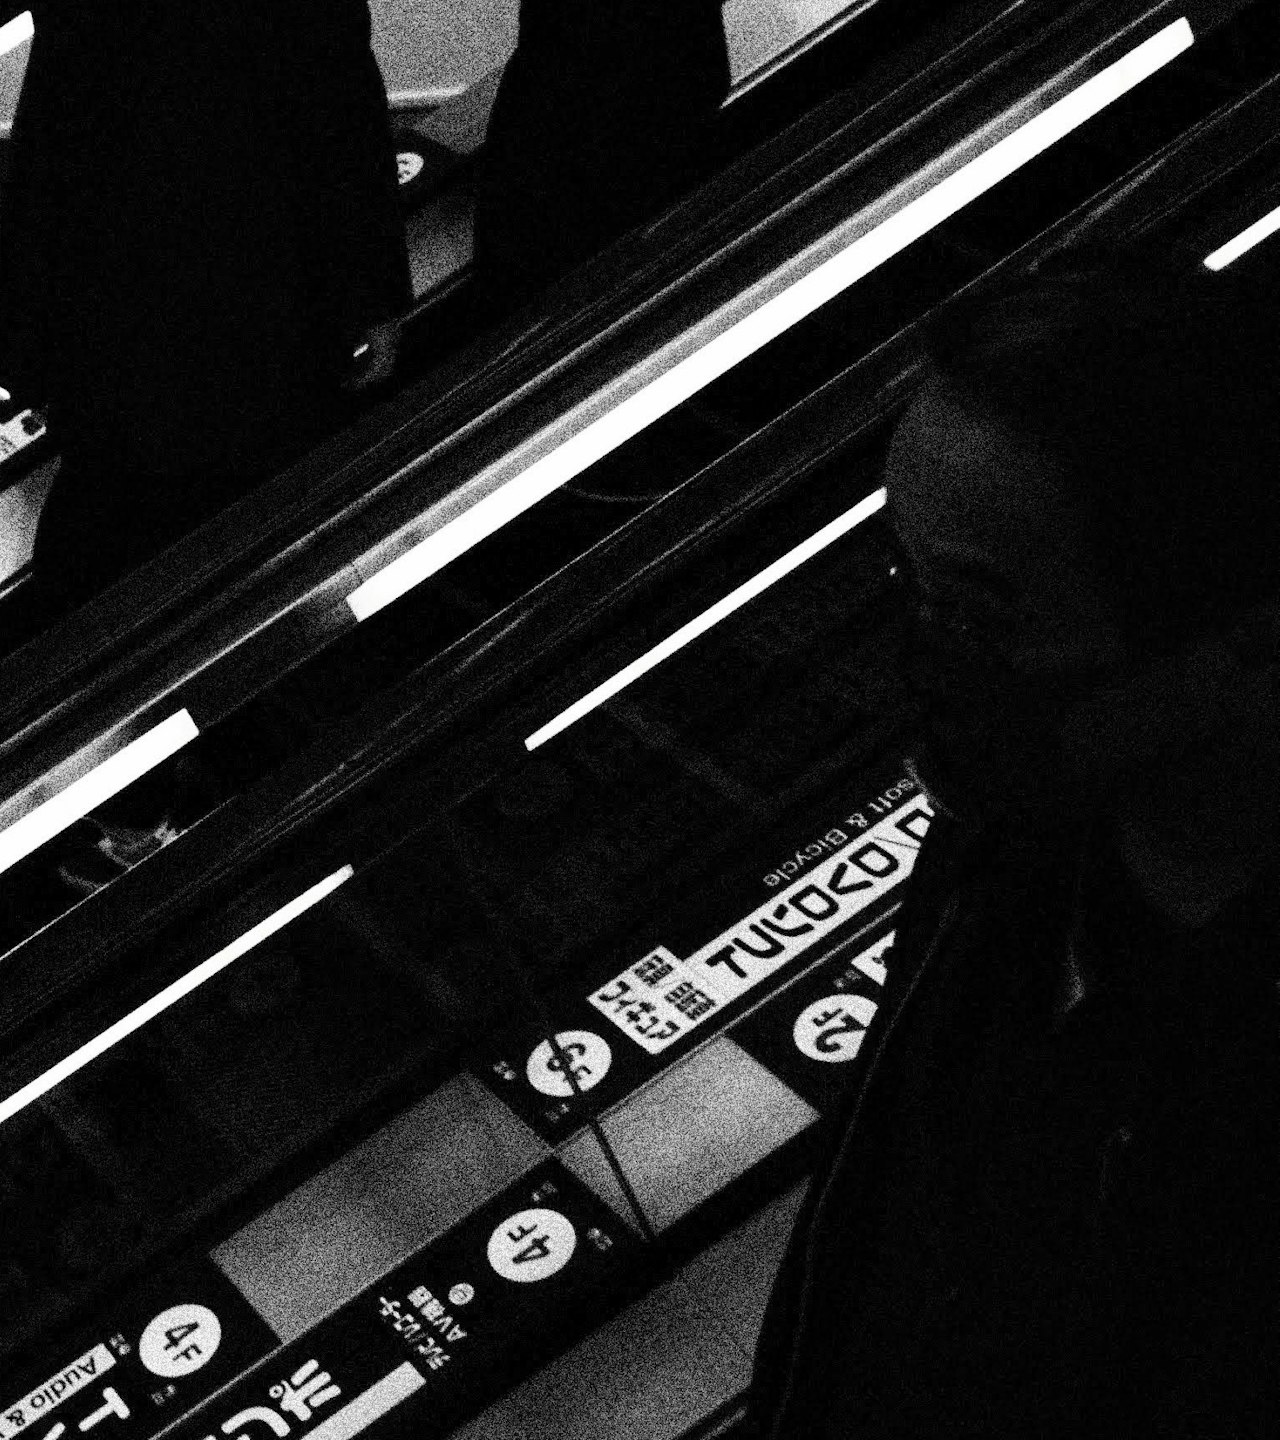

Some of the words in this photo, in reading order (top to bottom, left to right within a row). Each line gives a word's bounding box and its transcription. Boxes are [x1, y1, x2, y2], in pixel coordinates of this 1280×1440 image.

[758, 822, 849, 895] Bicycle
[598, 978, 679, 1046] フィギュア
[799, 997, 866, 1061] 2F
[496, 1212, 561, 1278] 4F
[154, 1312, 213, 1371] 4F
[406, 1283, 468, 1345] AV機器
[24, 1352, 103, 1415] Audio
[1, 1403, 29, 1432] &
